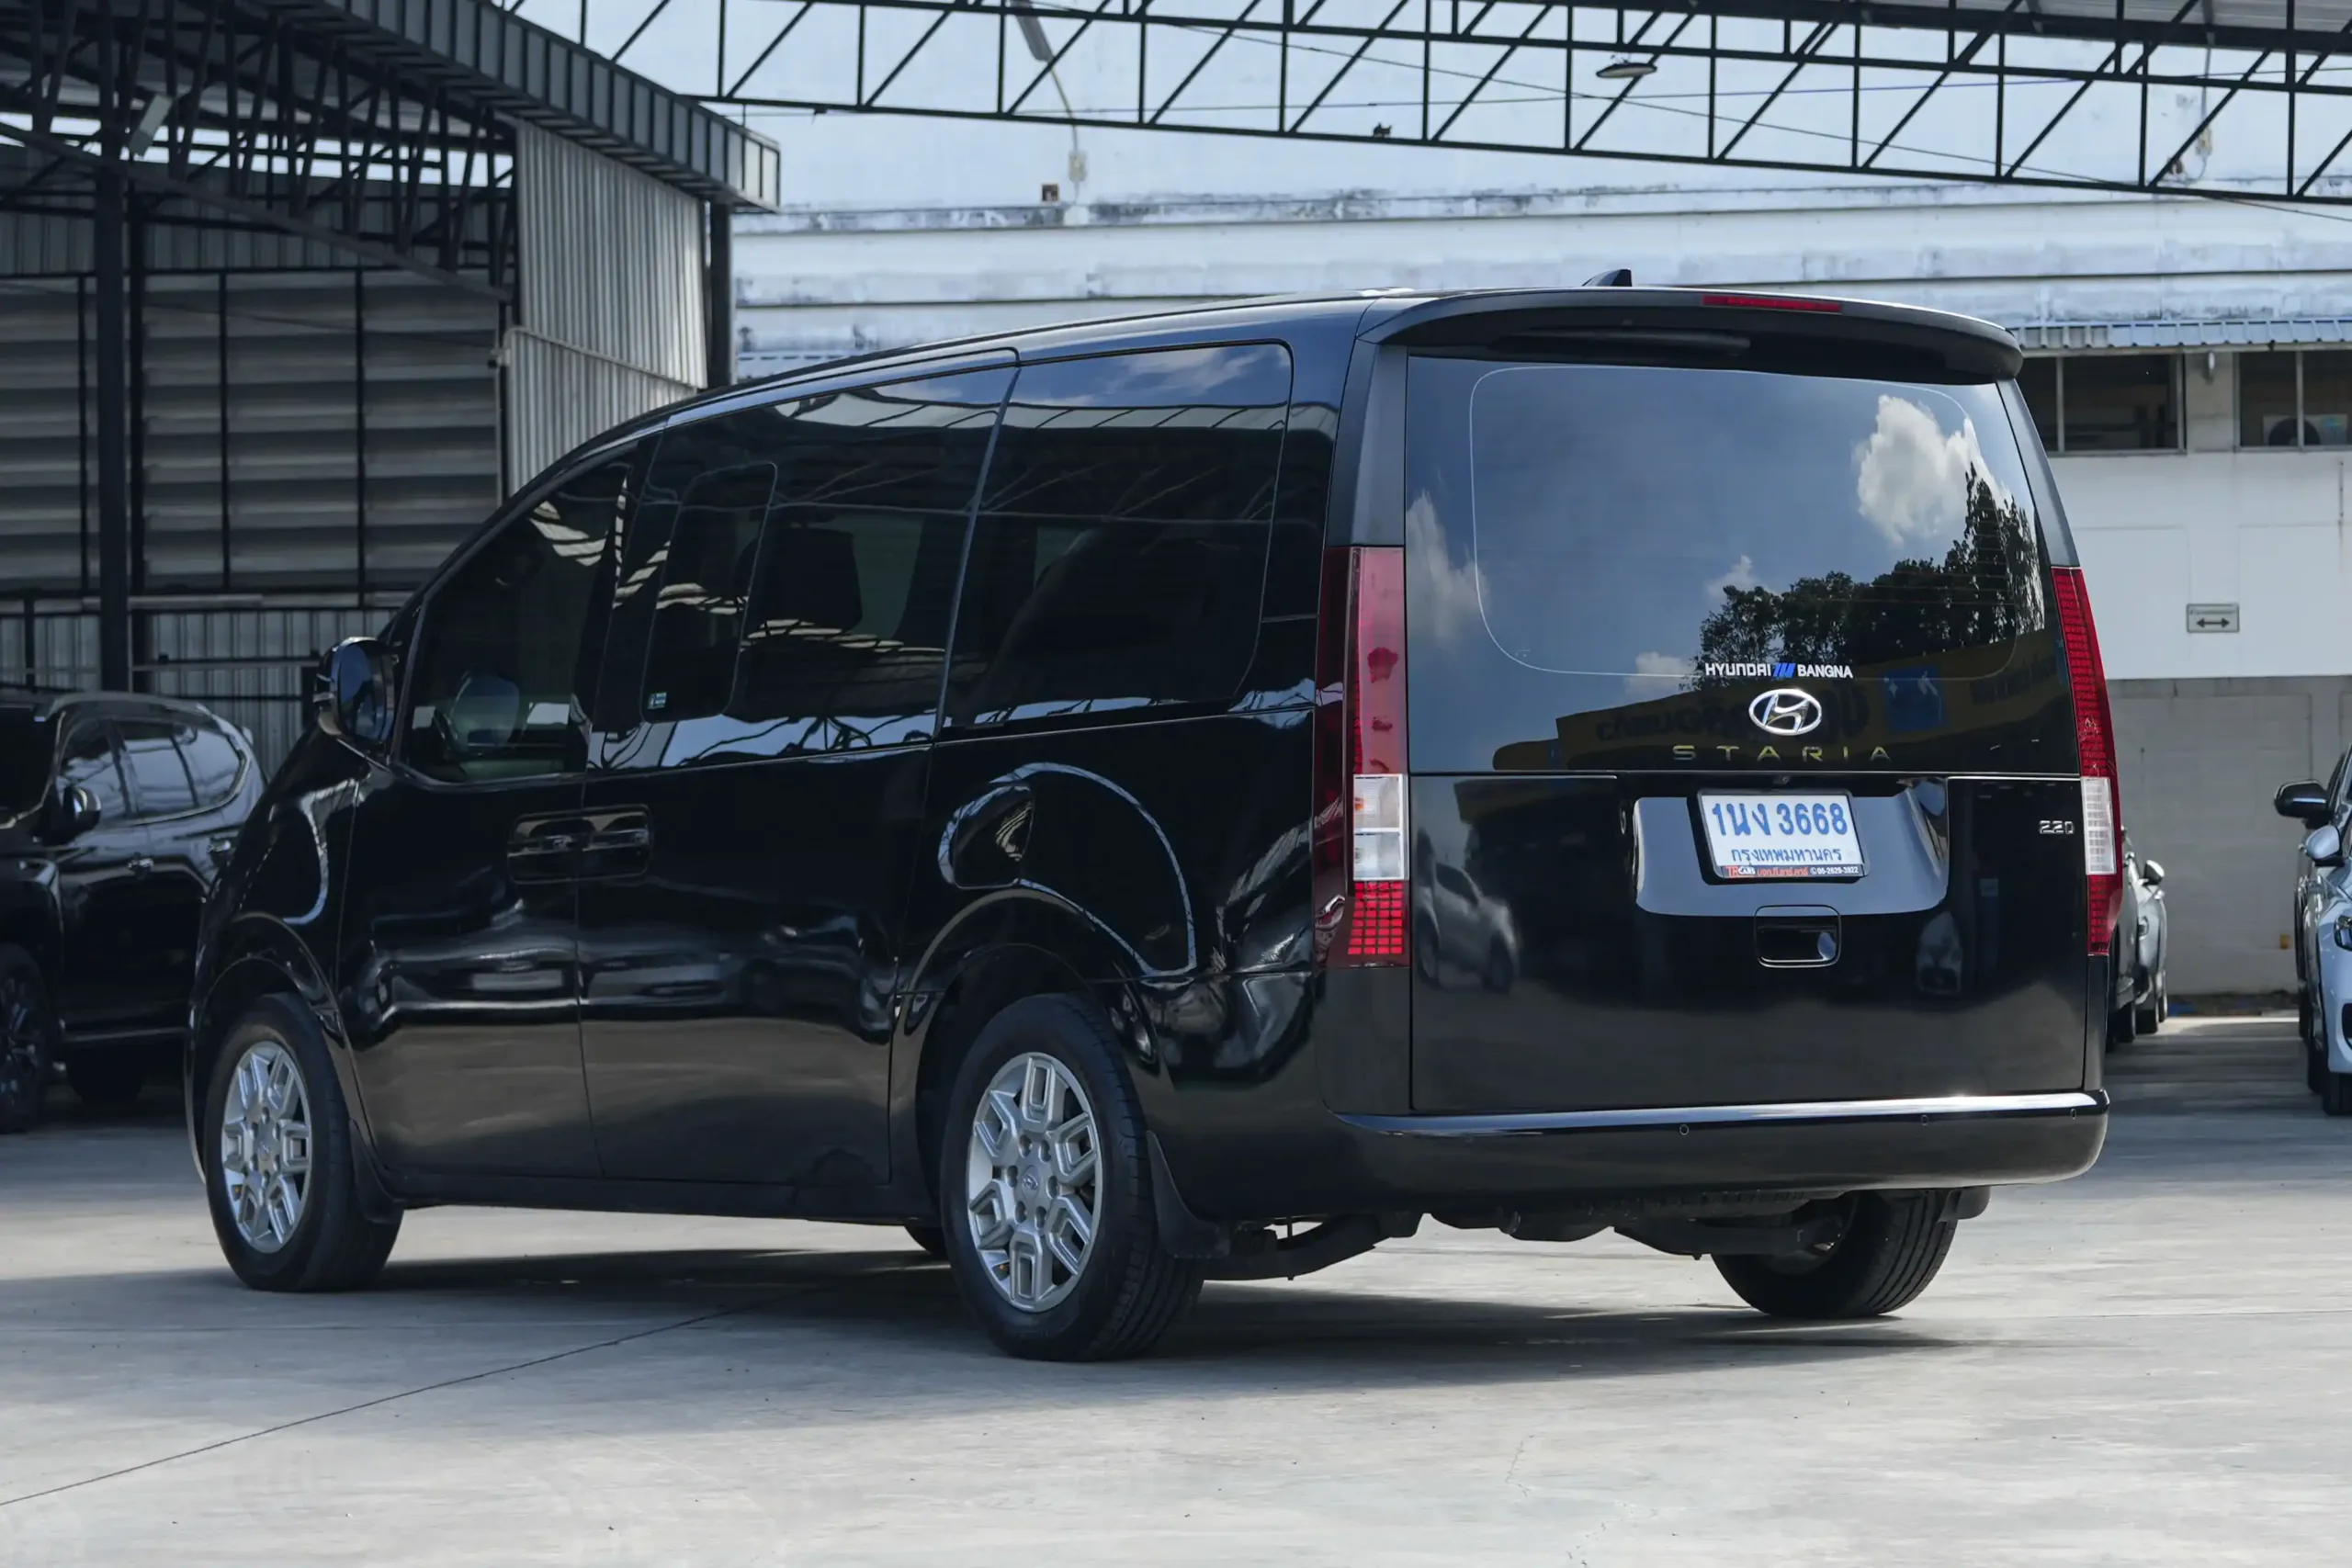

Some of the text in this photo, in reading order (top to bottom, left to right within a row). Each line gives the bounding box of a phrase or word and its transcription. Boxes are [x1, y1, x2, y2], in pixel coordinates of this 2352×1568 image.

[1705, 662, 1854, 679] HYUNDAI BANGNA
[1672, 745, 1893, 762] STARIA
[1712, 803, 1849, 836] 1นง 3668
[2040, 820, 2074, 834] 220
[1731, 848, 1842, 865] กรุงเทพมหานคร
